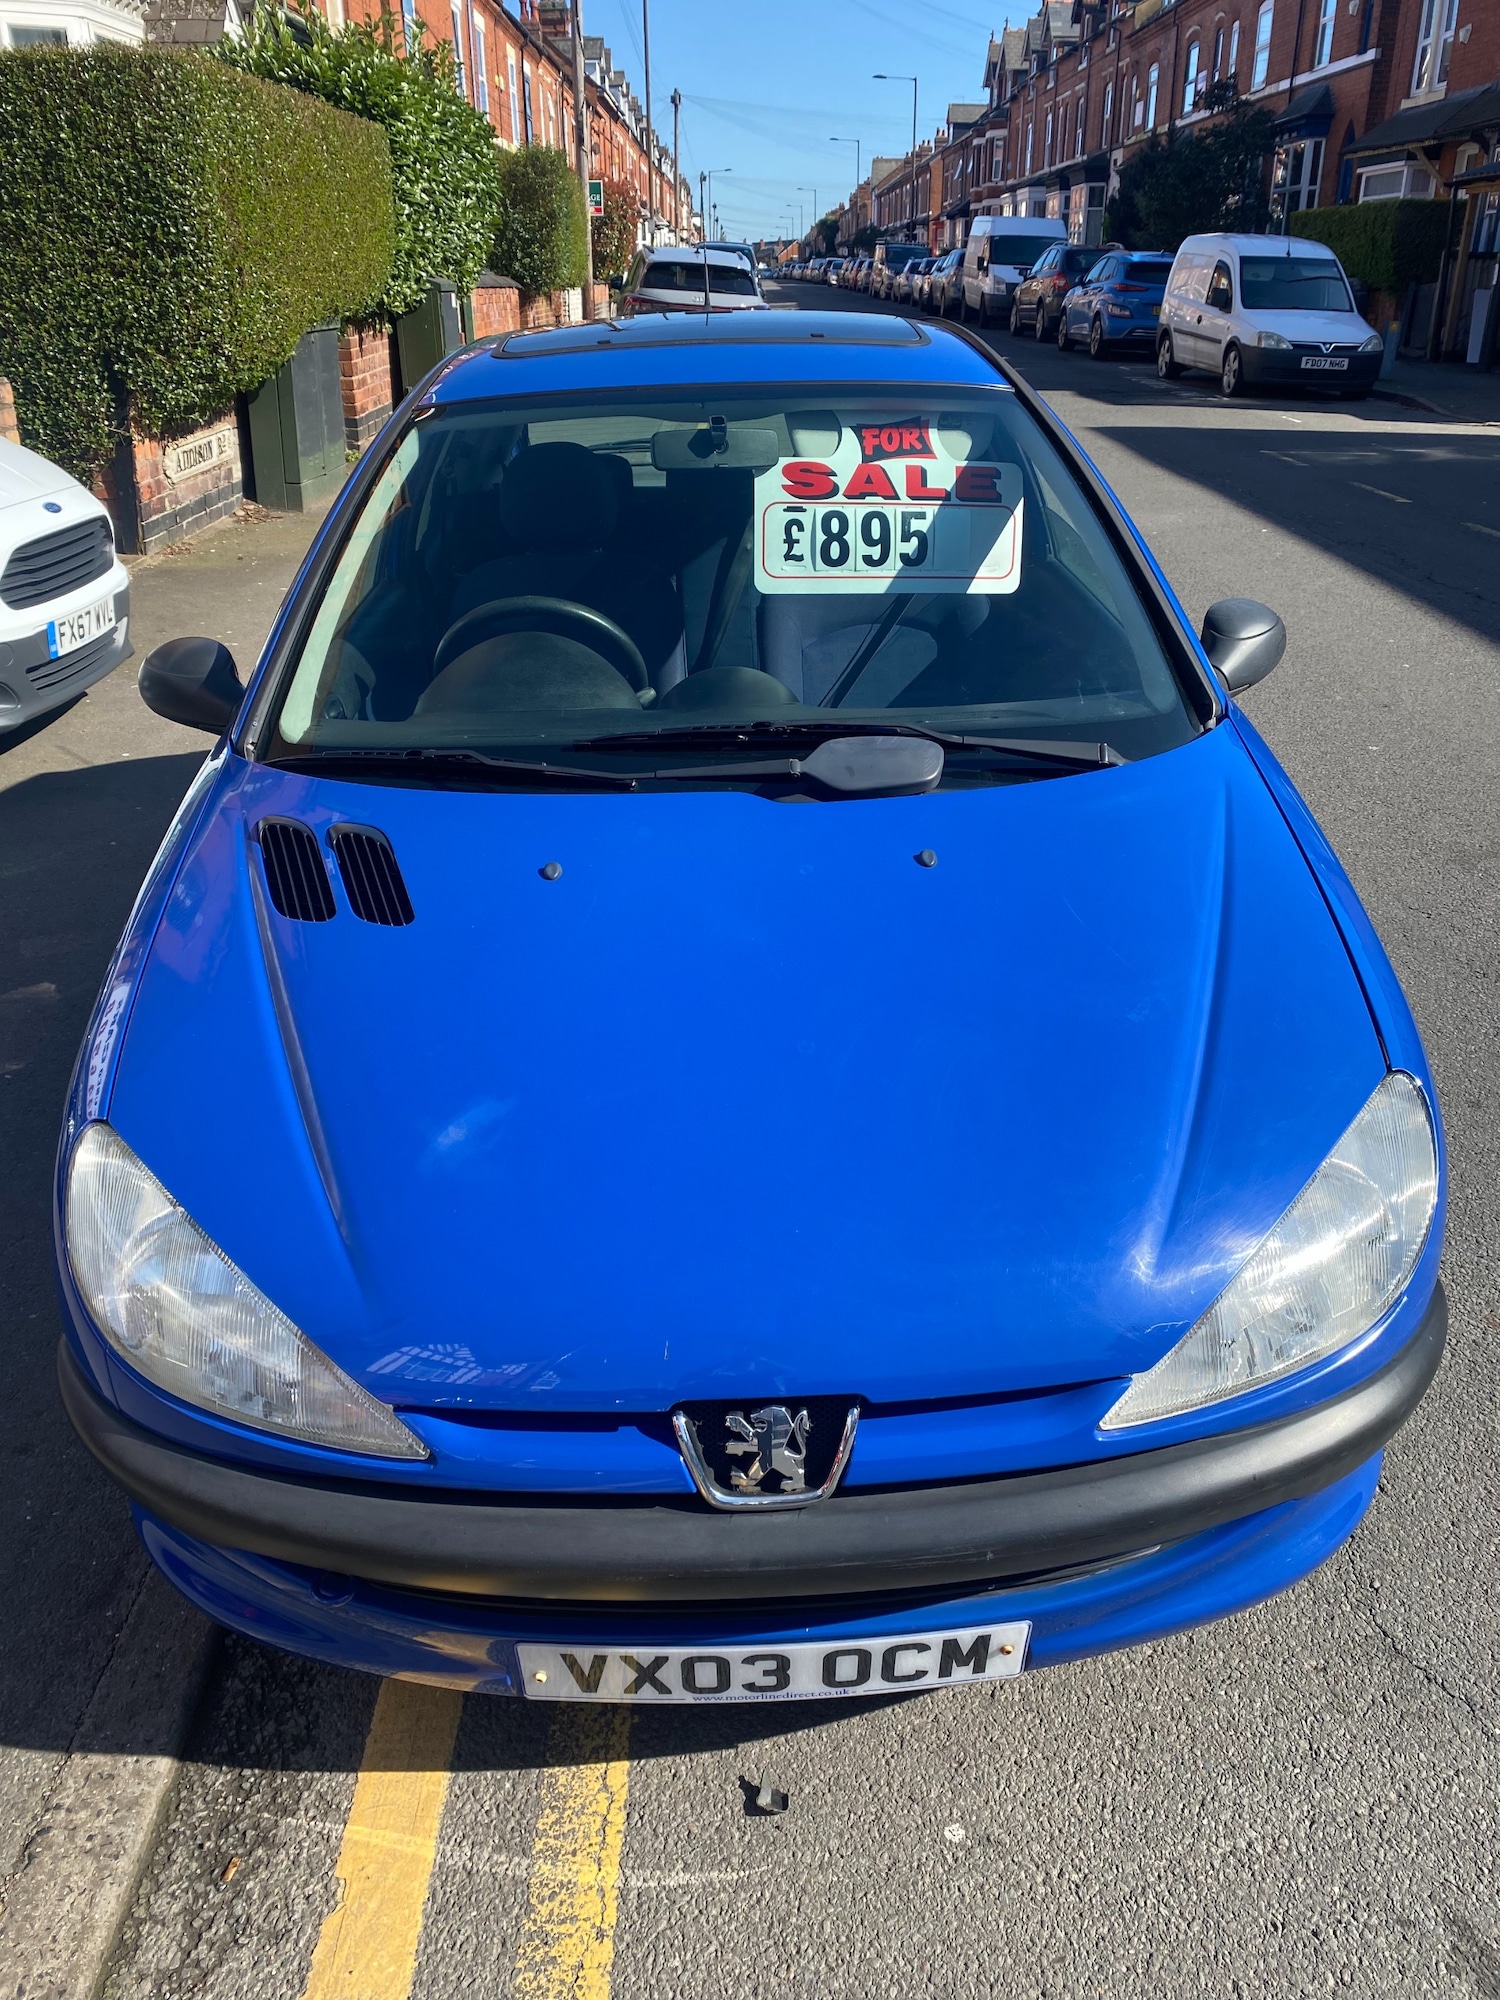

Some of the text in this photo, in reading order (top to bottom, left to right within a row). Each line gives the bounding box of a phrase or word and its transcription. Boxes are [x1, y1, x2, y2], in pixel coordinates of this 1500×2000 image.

[1305, 358, 1345, 368] FD07 NHG
[175, 441, 213, 472] ADDISON
[862, 427, 922, 455] FOR
[781, 461, 1001, 502] SALE
[783, 508, 928, 567] £895
[58, 599, 113, 648] FX67 WVL
[560, 1634, 993, 1695] VX03 OCM
[693, 1689, 850, 1702] www.motorlinedirect.co.uk
